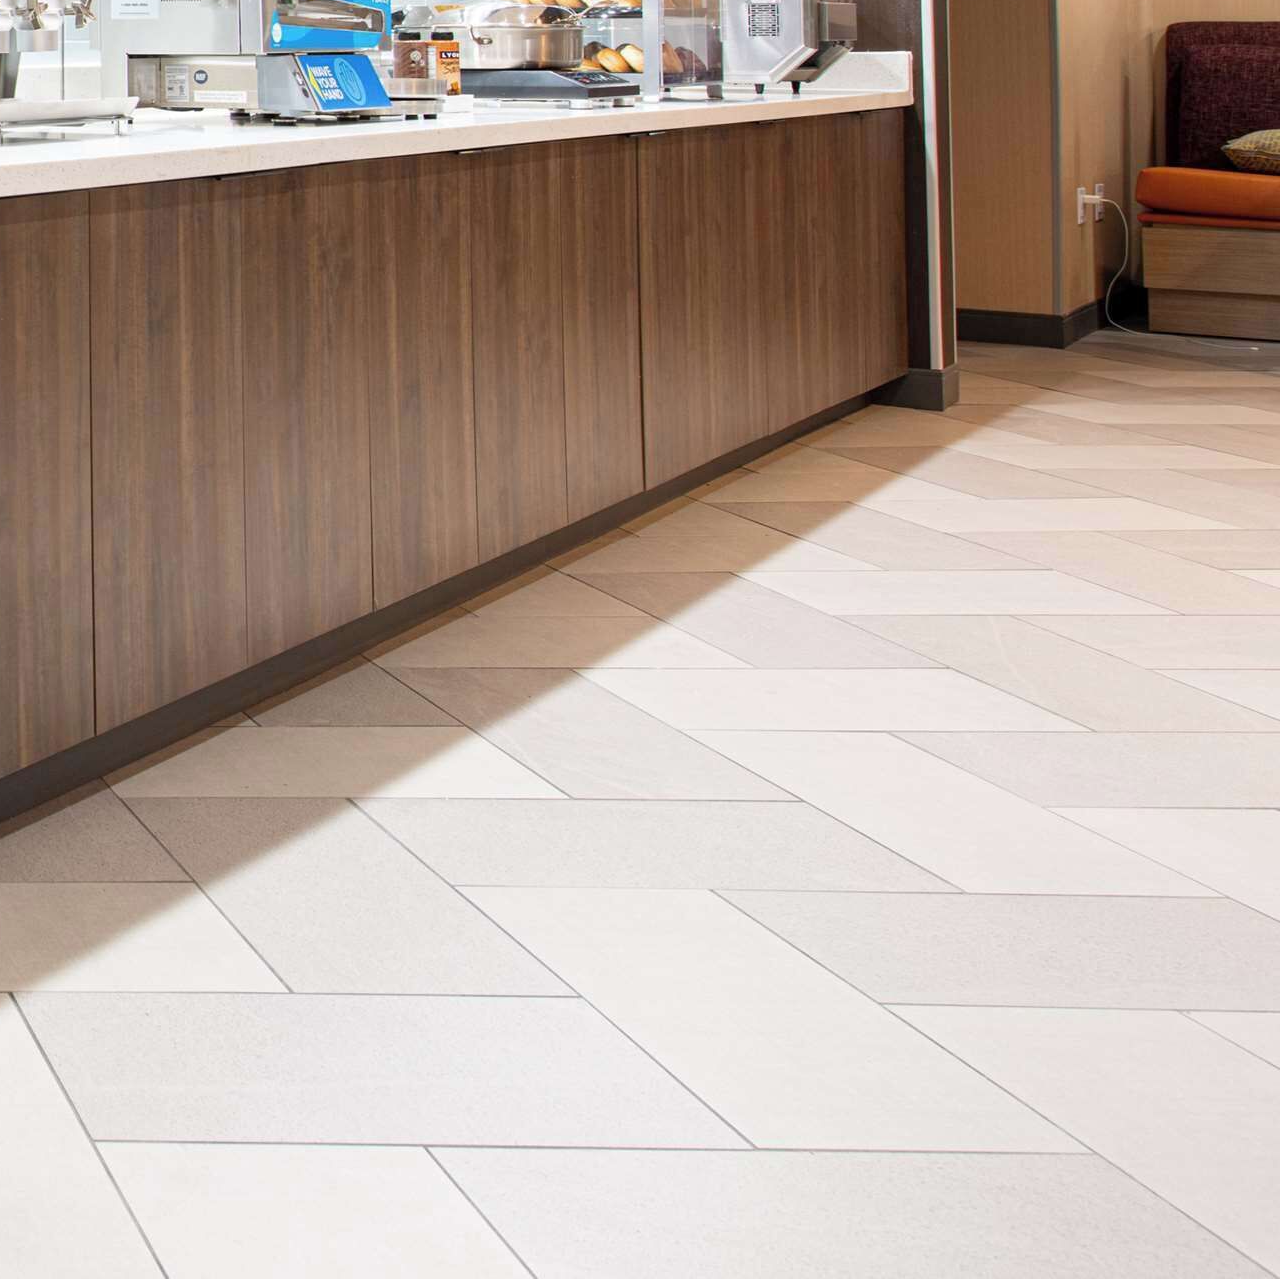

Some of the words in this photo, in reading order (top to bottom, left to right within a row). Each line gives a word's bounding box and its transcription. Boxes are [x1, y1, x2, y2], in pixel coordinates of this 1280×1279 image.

[311, 65, 333, 77] WAVE
[317, 77, 338, 89] YOUR
[322, 89, 344, 100] HAND
